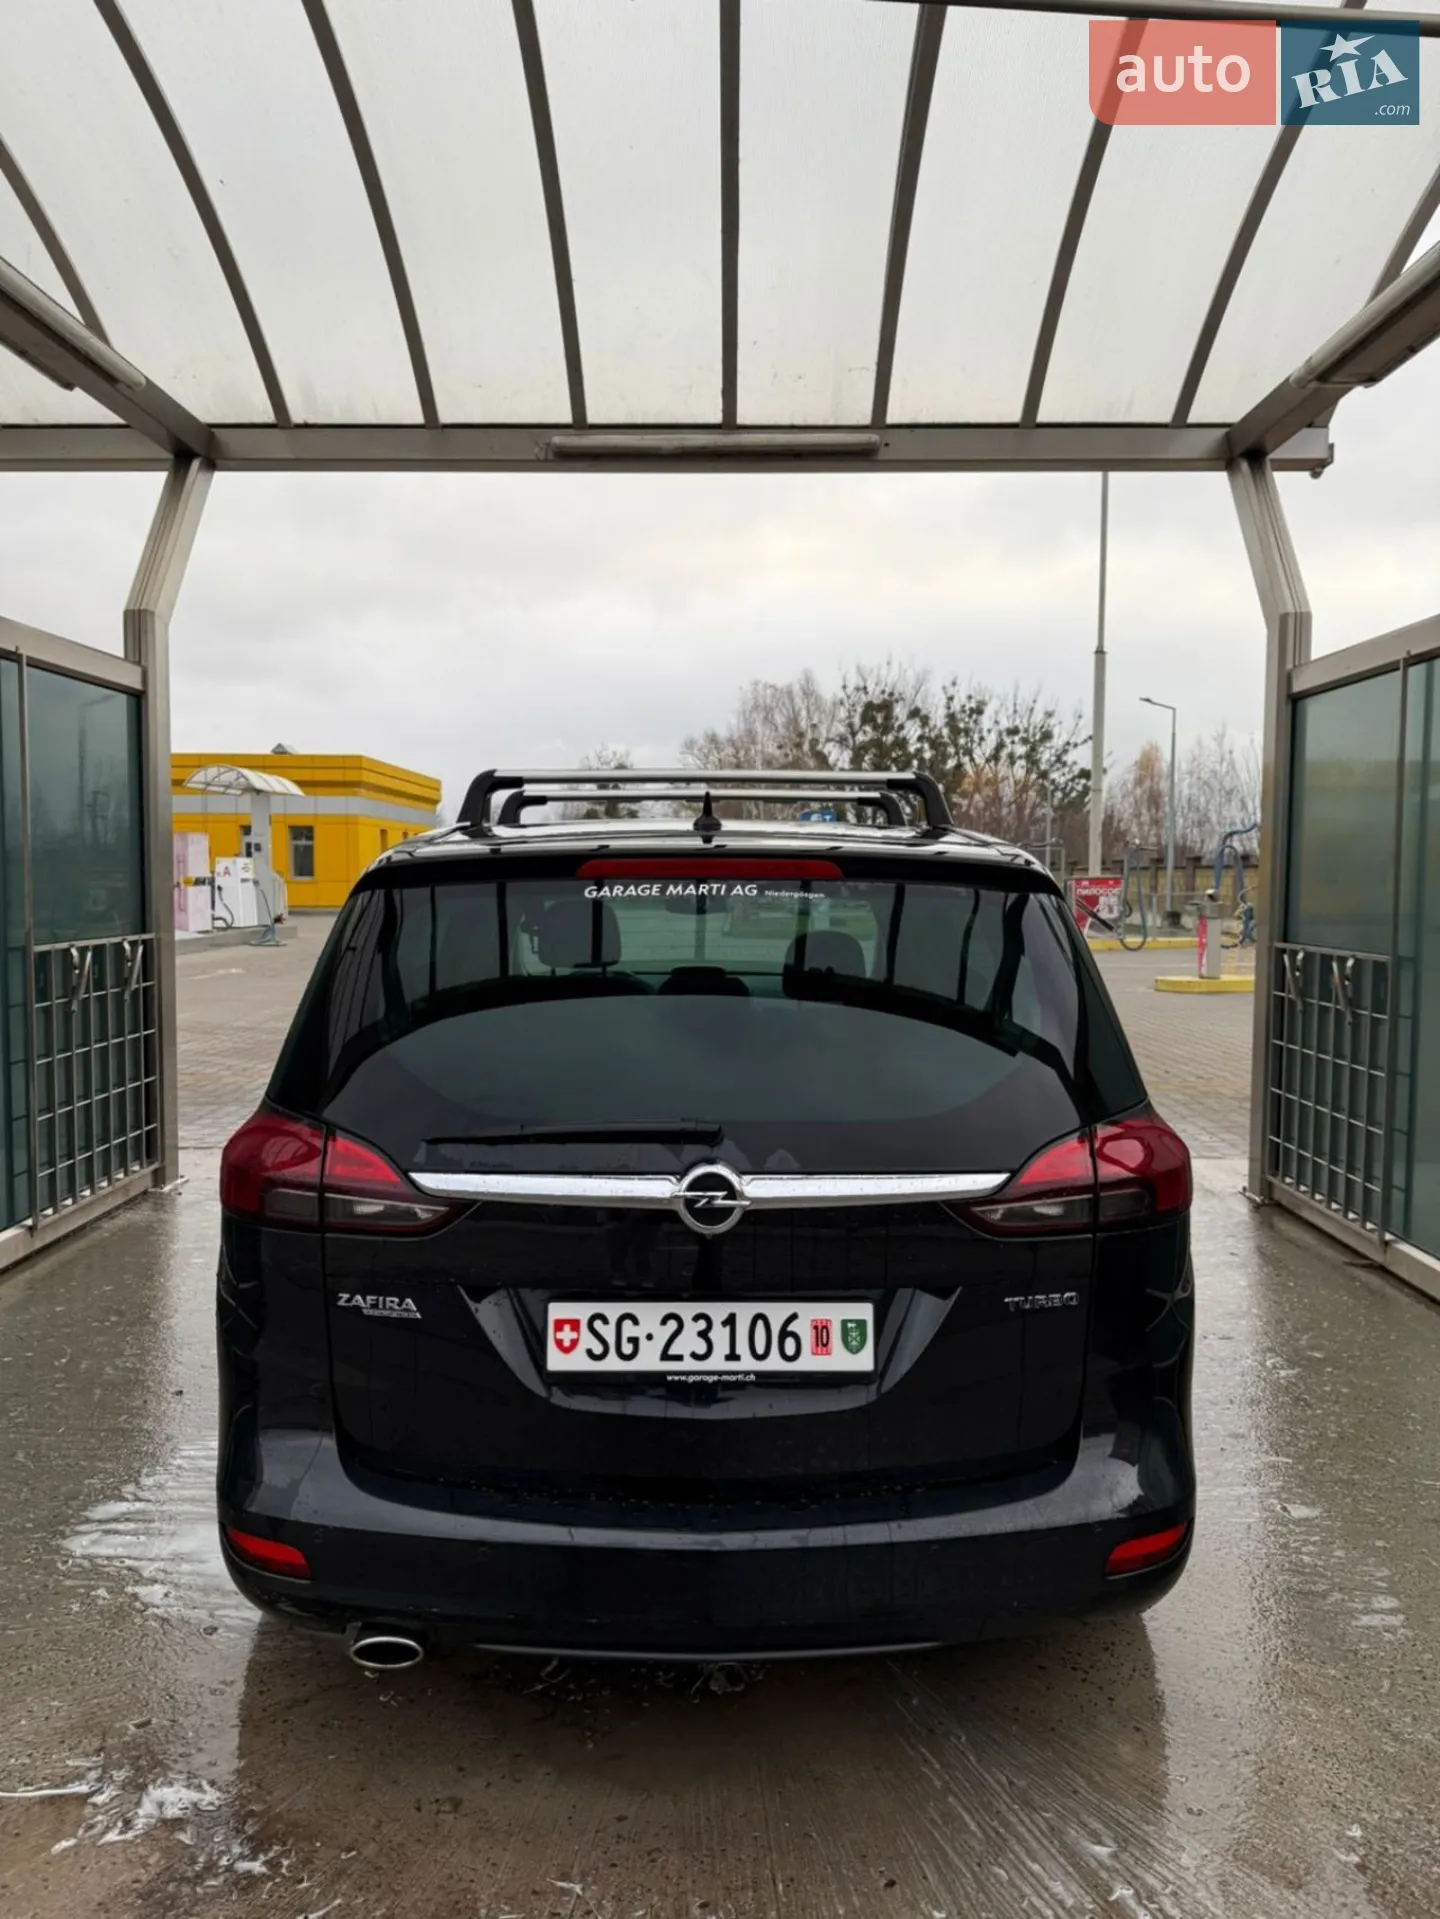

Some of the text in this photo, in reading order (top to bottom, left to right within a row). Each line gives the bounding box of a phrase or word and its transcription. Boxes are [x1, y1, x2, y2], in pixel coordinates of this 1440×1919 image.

[584, 884, 661, 899] GARAGE
[666, 884, 725, 897] MARTI
[730, 884, 758, 897] AG
[336, 1292, 417, 1311] ZAFIRA
[1003, 1291, 1080, 1312] TURBO
[813, 1325, 830, 1348] 10
[666, 1373, 757, 1384] www.garage-marti.ch
